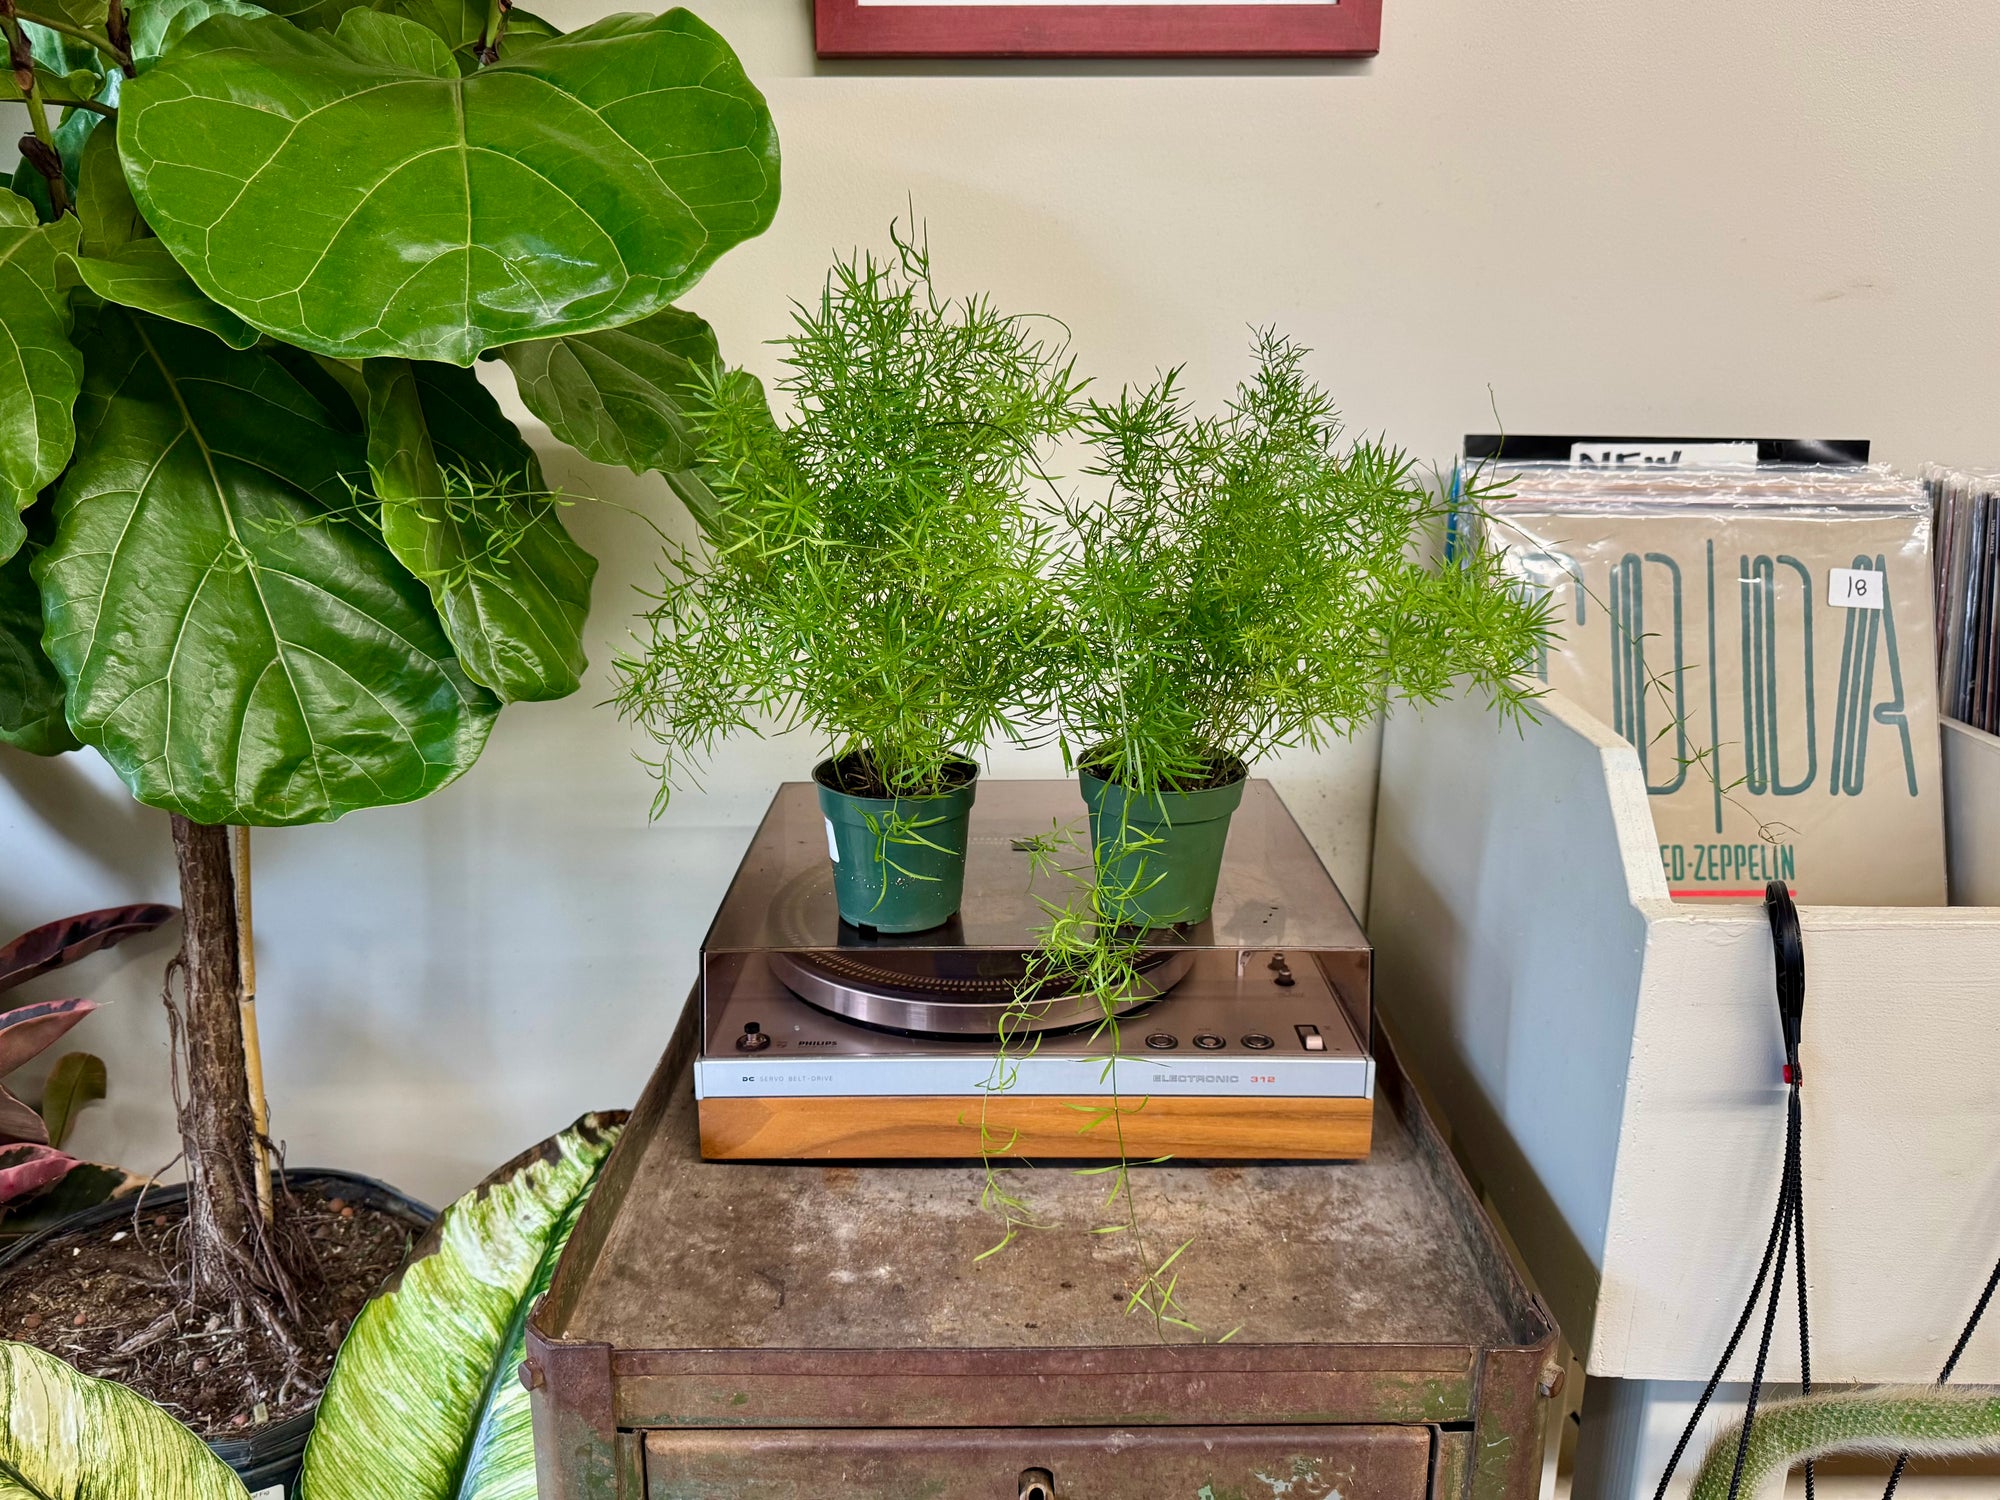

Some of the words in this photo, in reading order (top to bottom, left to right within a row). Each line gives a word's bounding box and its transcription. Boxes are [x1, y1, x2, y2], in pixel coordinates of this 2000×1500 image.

[1847, 575, 1867, 598] 18
[1152, 1075, 1239, 1083] ELECTRONIC
[1250, 1075, 1276, 1083] 312
